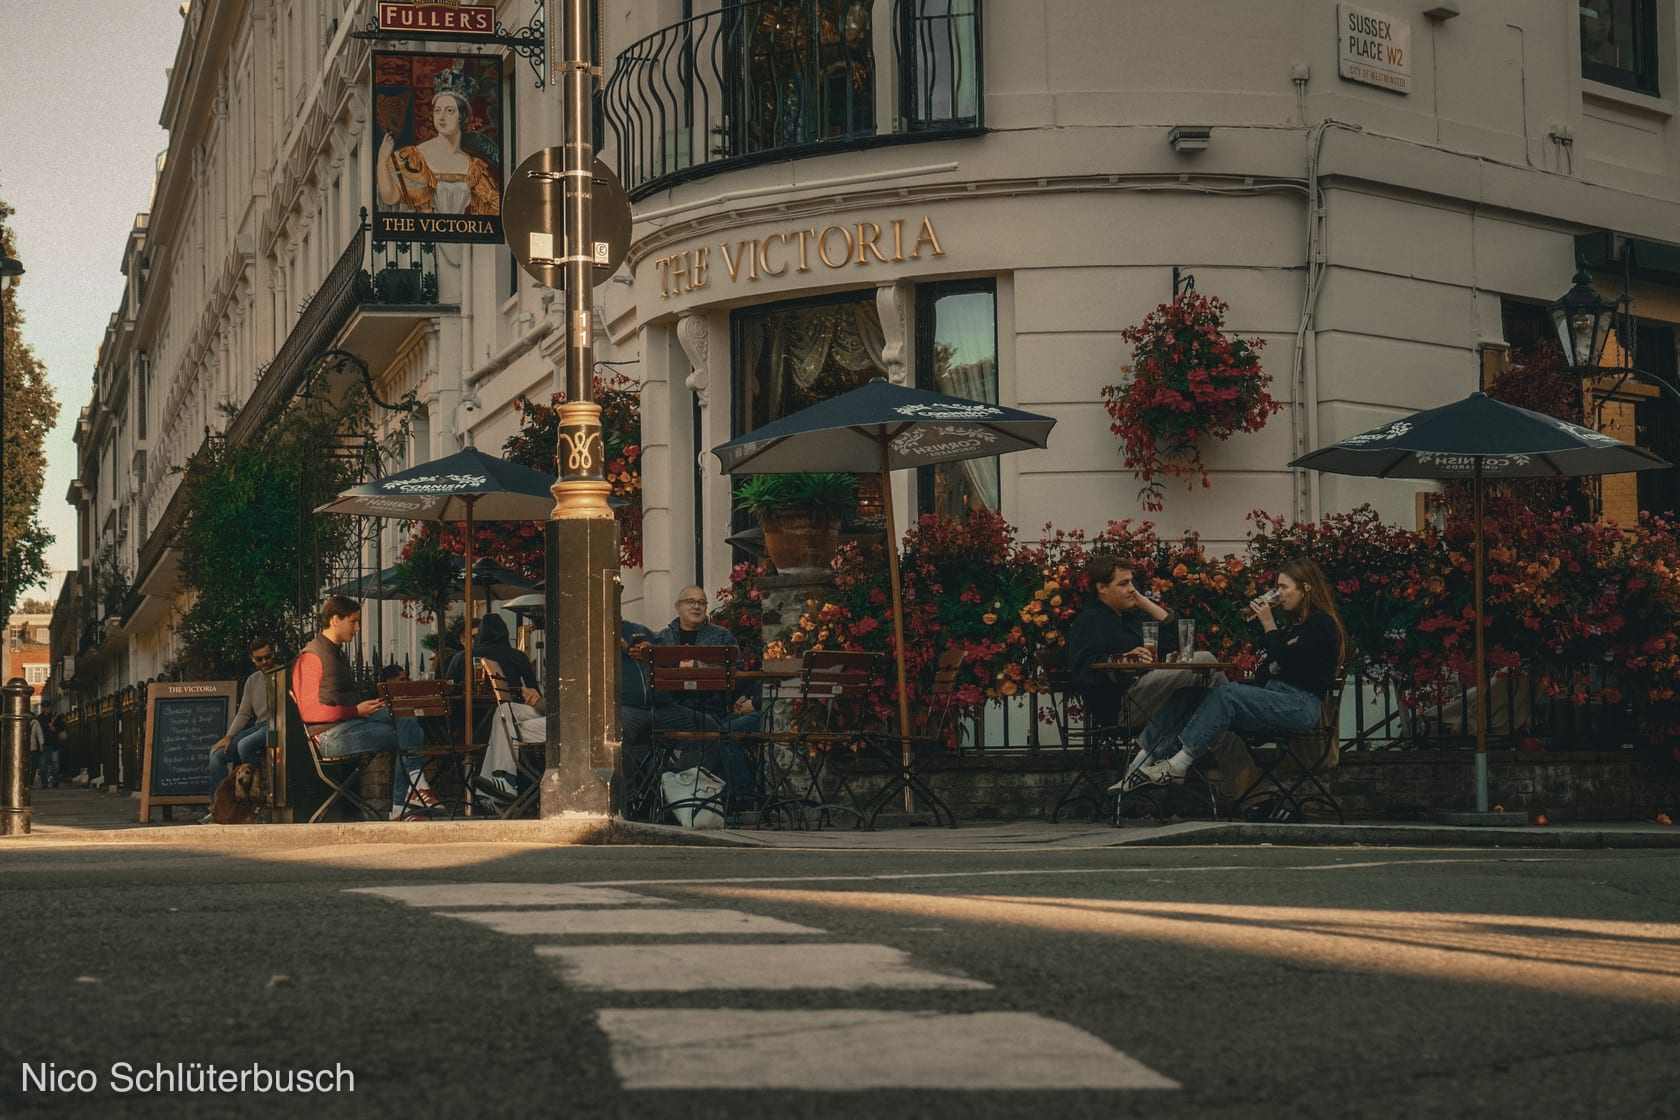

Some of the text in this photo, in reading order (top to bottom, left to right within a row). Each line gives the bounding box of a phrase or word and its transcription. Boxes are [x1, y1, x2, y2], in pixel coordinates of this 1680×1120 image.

[386, 6, 487, 30] FULLER'S
[1349, 12, 1392, 41] SUSSEX
[1349, 35, 1404, 68] PLACE W2
[1349, 65, 1406, 88] CITY OF WESTMINSTER
[382, 218, 495, 235] THE VICTORIA
[655, 215, 947, 299] THE VICTORIA
[168, 685, 217, 694] THE VICTORIA
